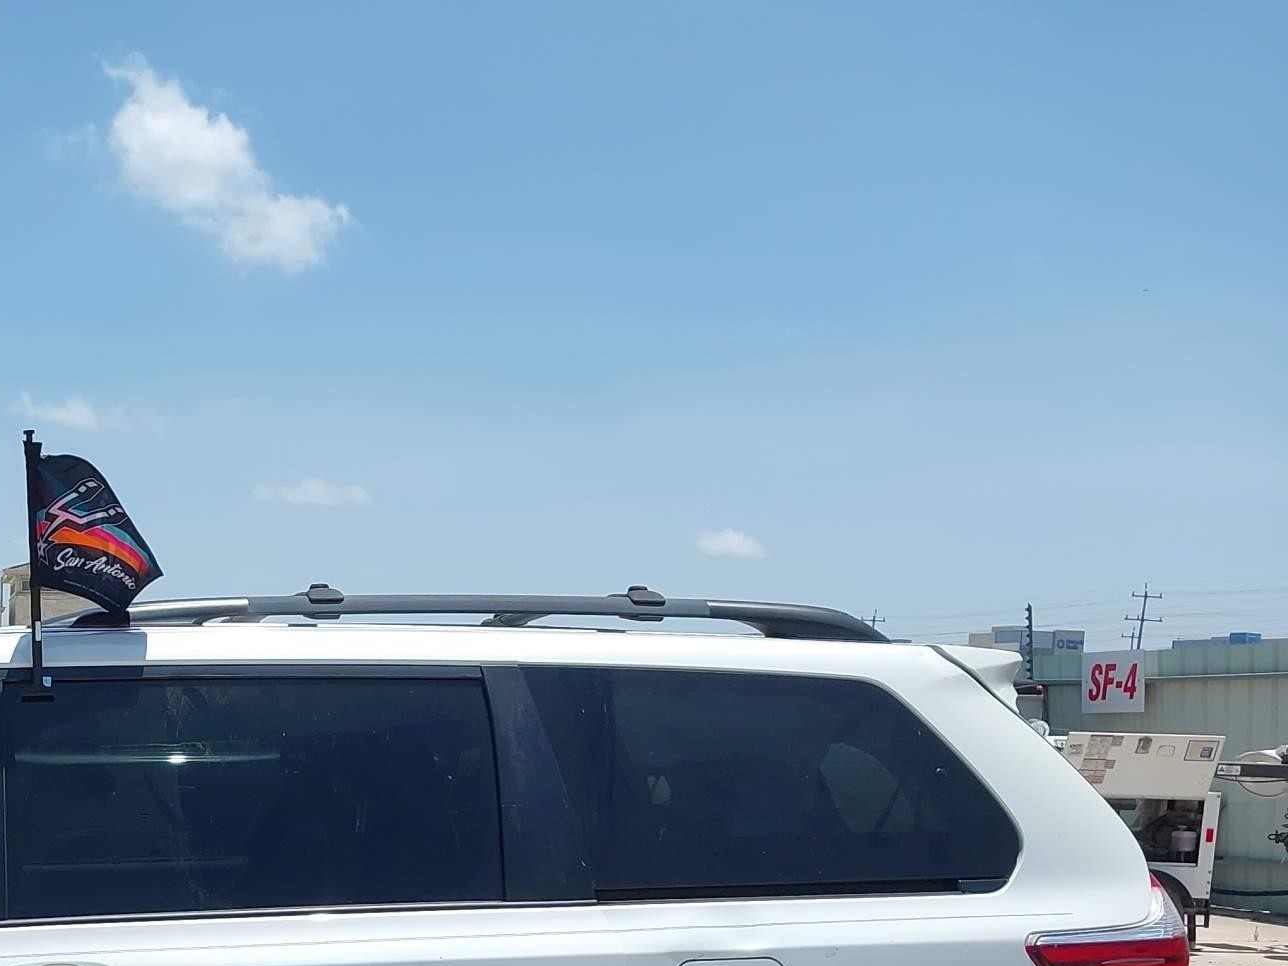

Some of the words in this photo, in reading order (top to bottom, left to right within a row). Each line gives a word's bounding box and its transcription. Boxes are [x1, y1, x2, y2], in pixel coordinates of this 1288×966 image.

[53, 547, 85, 571] San
[83, 555, 136, 590] Antonio
[1088, 663, 1138, 701] SF-4
